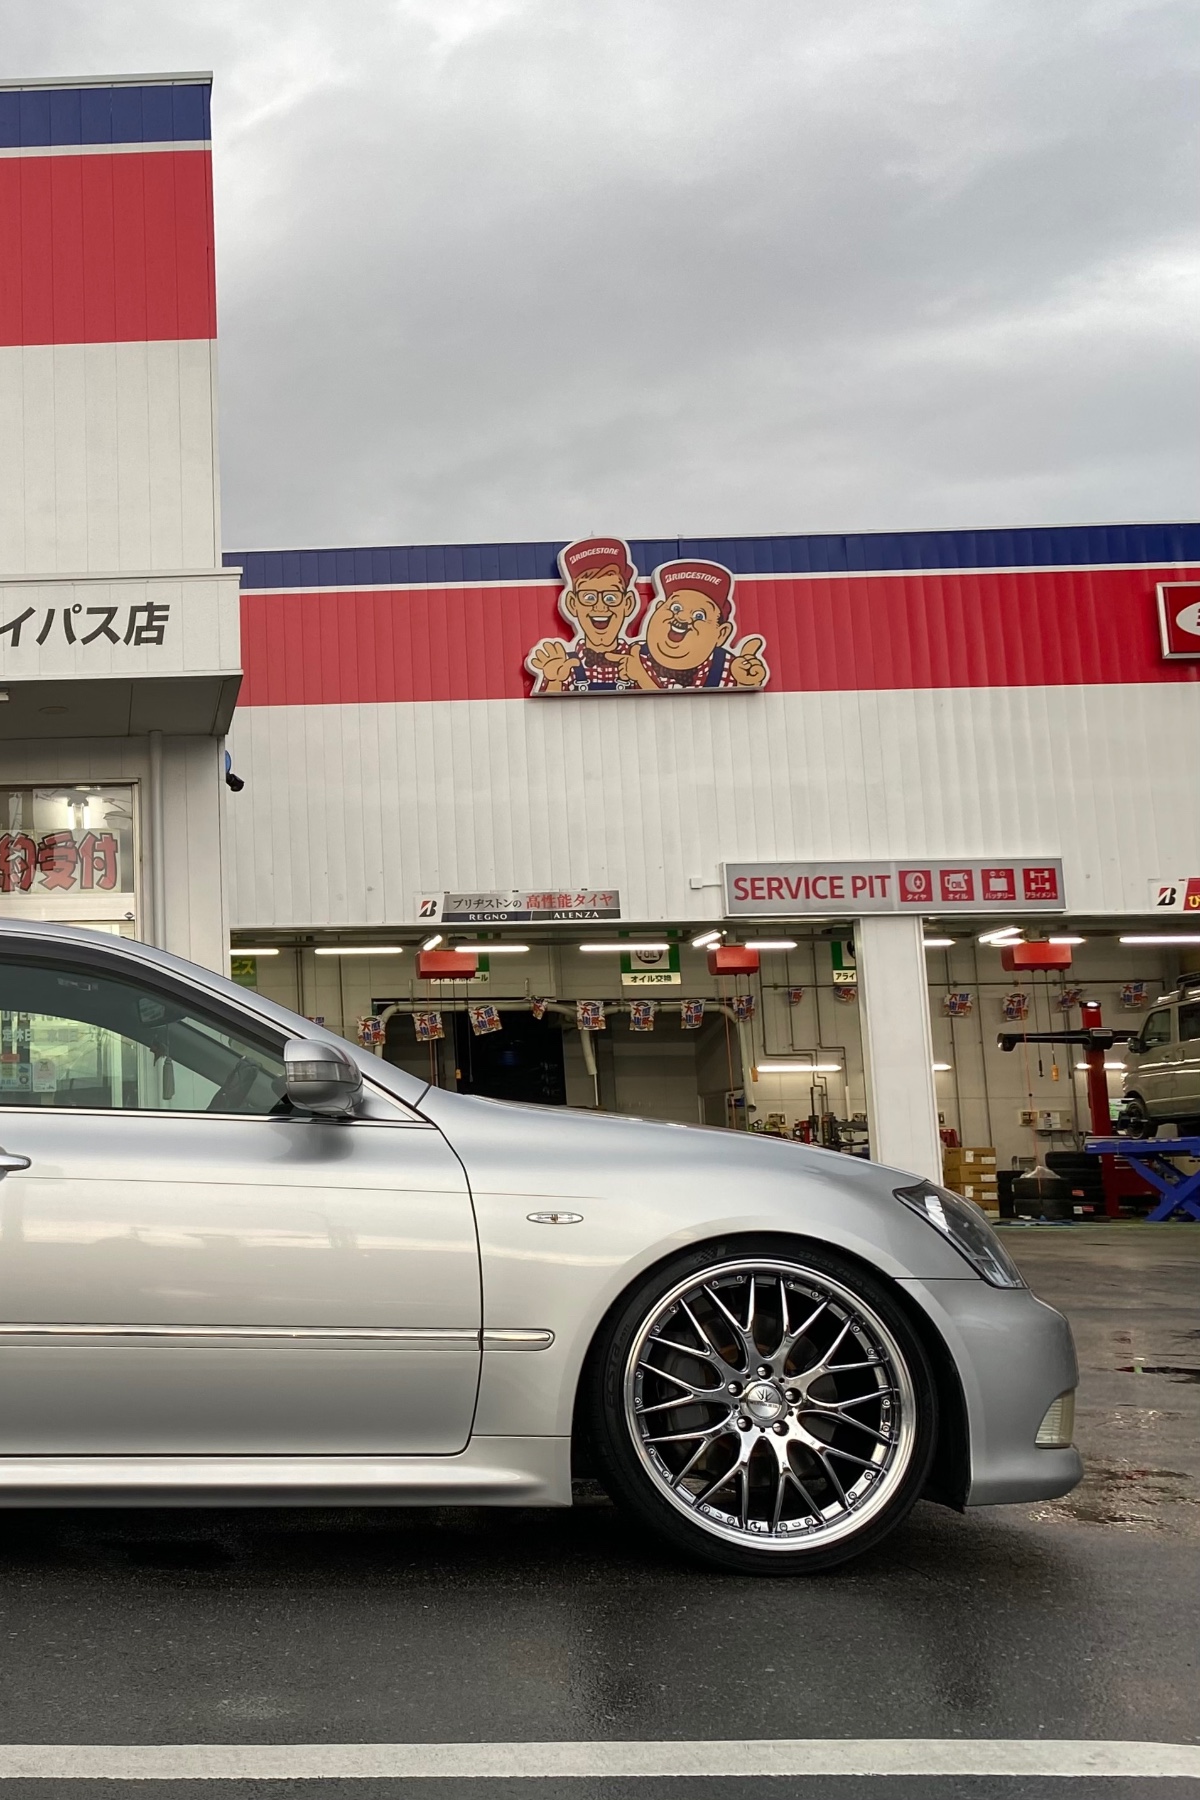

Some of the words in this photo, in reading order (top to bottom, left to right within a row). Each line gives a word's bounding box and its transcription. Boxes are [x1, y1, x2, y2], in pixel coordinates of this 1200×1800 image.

[569, 547, 620, 564] BRIDGESTONE
[664, 571, 722, 586] BRIDGESTONE
[733, 876, 845, 901] SERVICE
[851, 875, 891, 898] PIT
[1025, 891, 1057, 899] アライメント
[453, 898, 522, 910] ブリヂストンの
[526, 893, 614, 909] 高性能タイヤ
[469, 913, 508, 921] REGNO
[553, 911, 600, 919] ALENZA
[630, 974, 672, 983] オイル交換
[2, 1028, 34, 1042] 定休日
